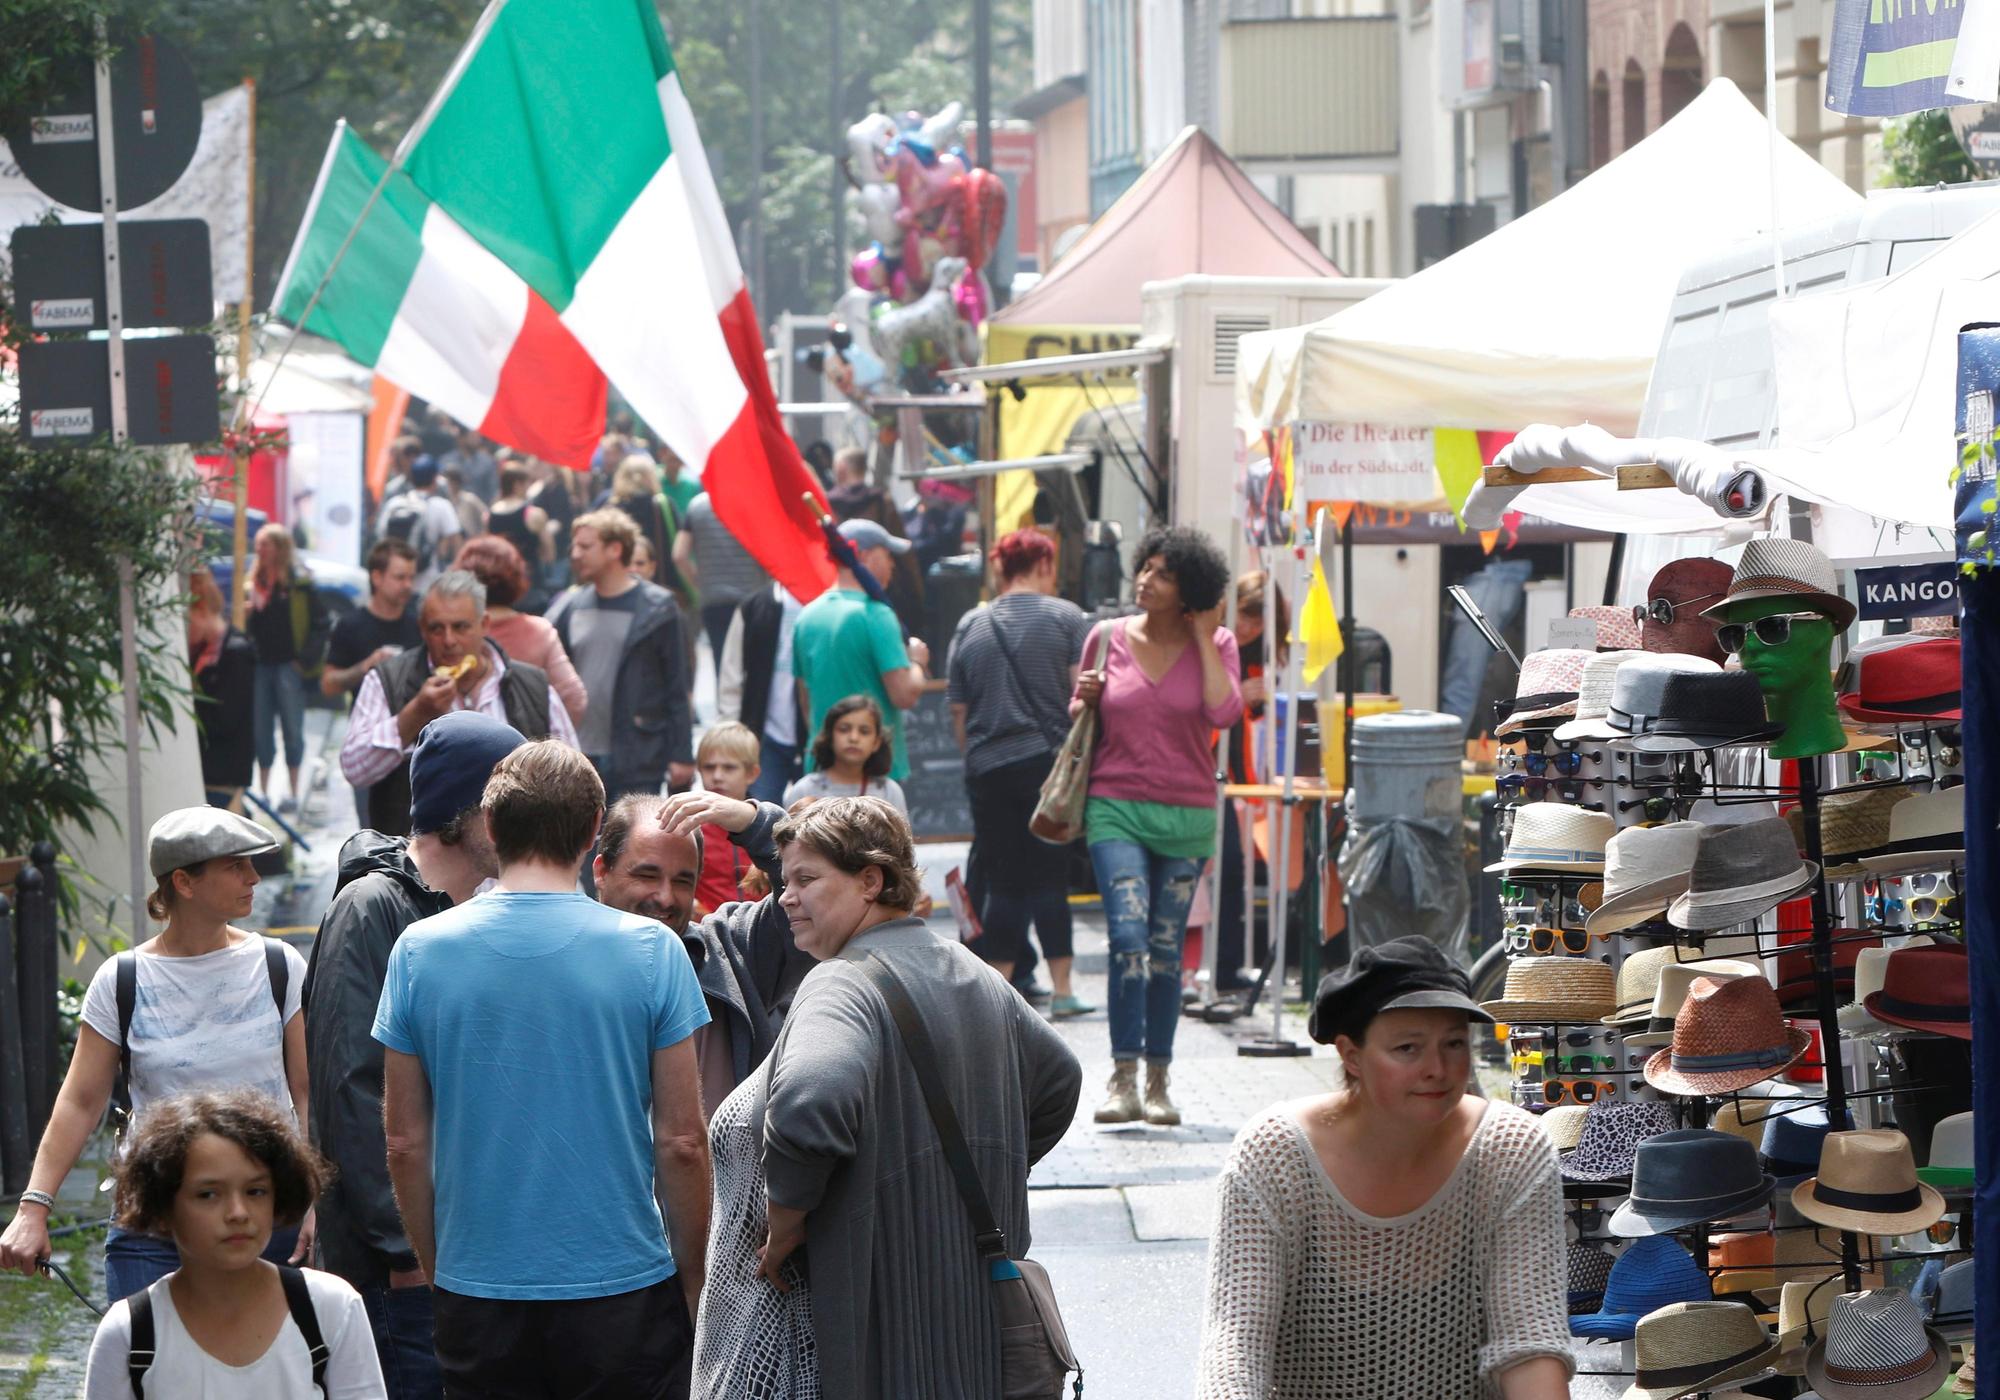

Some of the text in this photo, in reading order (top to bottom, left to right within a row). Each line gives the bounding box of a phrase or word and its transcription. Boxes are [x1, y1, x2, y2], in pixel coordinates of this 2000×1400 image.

[40, 304, 92, 319] FABEMA
[40, 414, 89, 429] FABEMA
[1311, 423, 1345, 442] Die
[1310, 461, 1324, 474] in
[1328, 460, 1353, 474] der
[1866, 580, 1960, 603] KANGO
